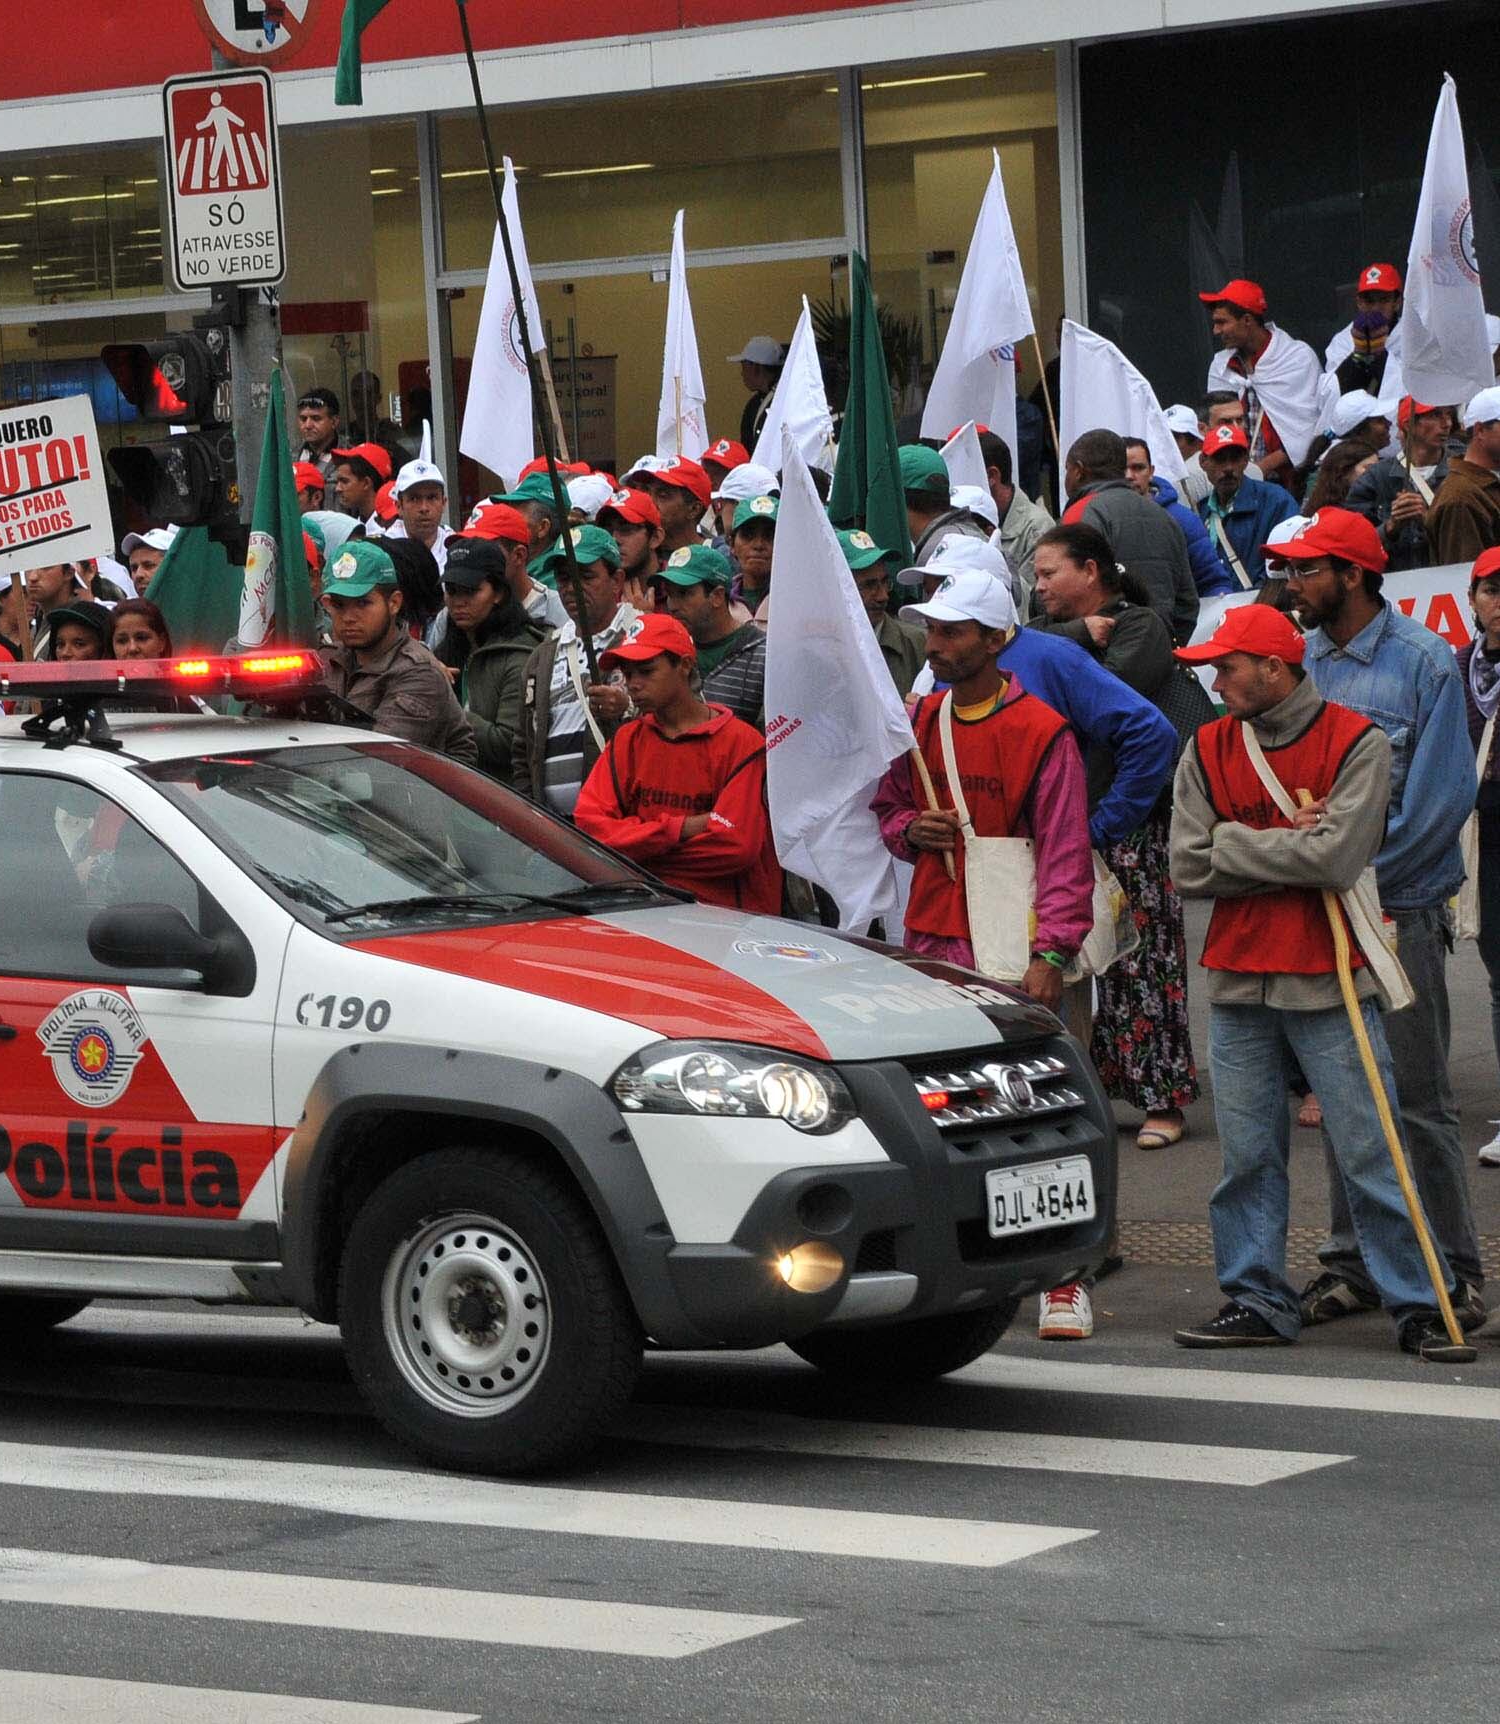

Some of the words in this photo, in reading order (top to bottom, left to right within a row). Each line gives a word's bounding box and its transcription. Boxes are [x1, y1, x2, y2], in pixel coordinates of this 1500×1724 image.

[208, 194, 245, 227] SÓ
[182, 230, 276, 254] ATRAVESSE
[186, 259, 210, 276] NO
[218, 254, 275, 275] VERDE
[22, 489, 68, 516] PARA
[5, 526, 16, 545] E
[16, 510, 74, 540] TODOS
[97, 994, 142, 1043] MILITAR
[316, 994, 392, 1032] 190
